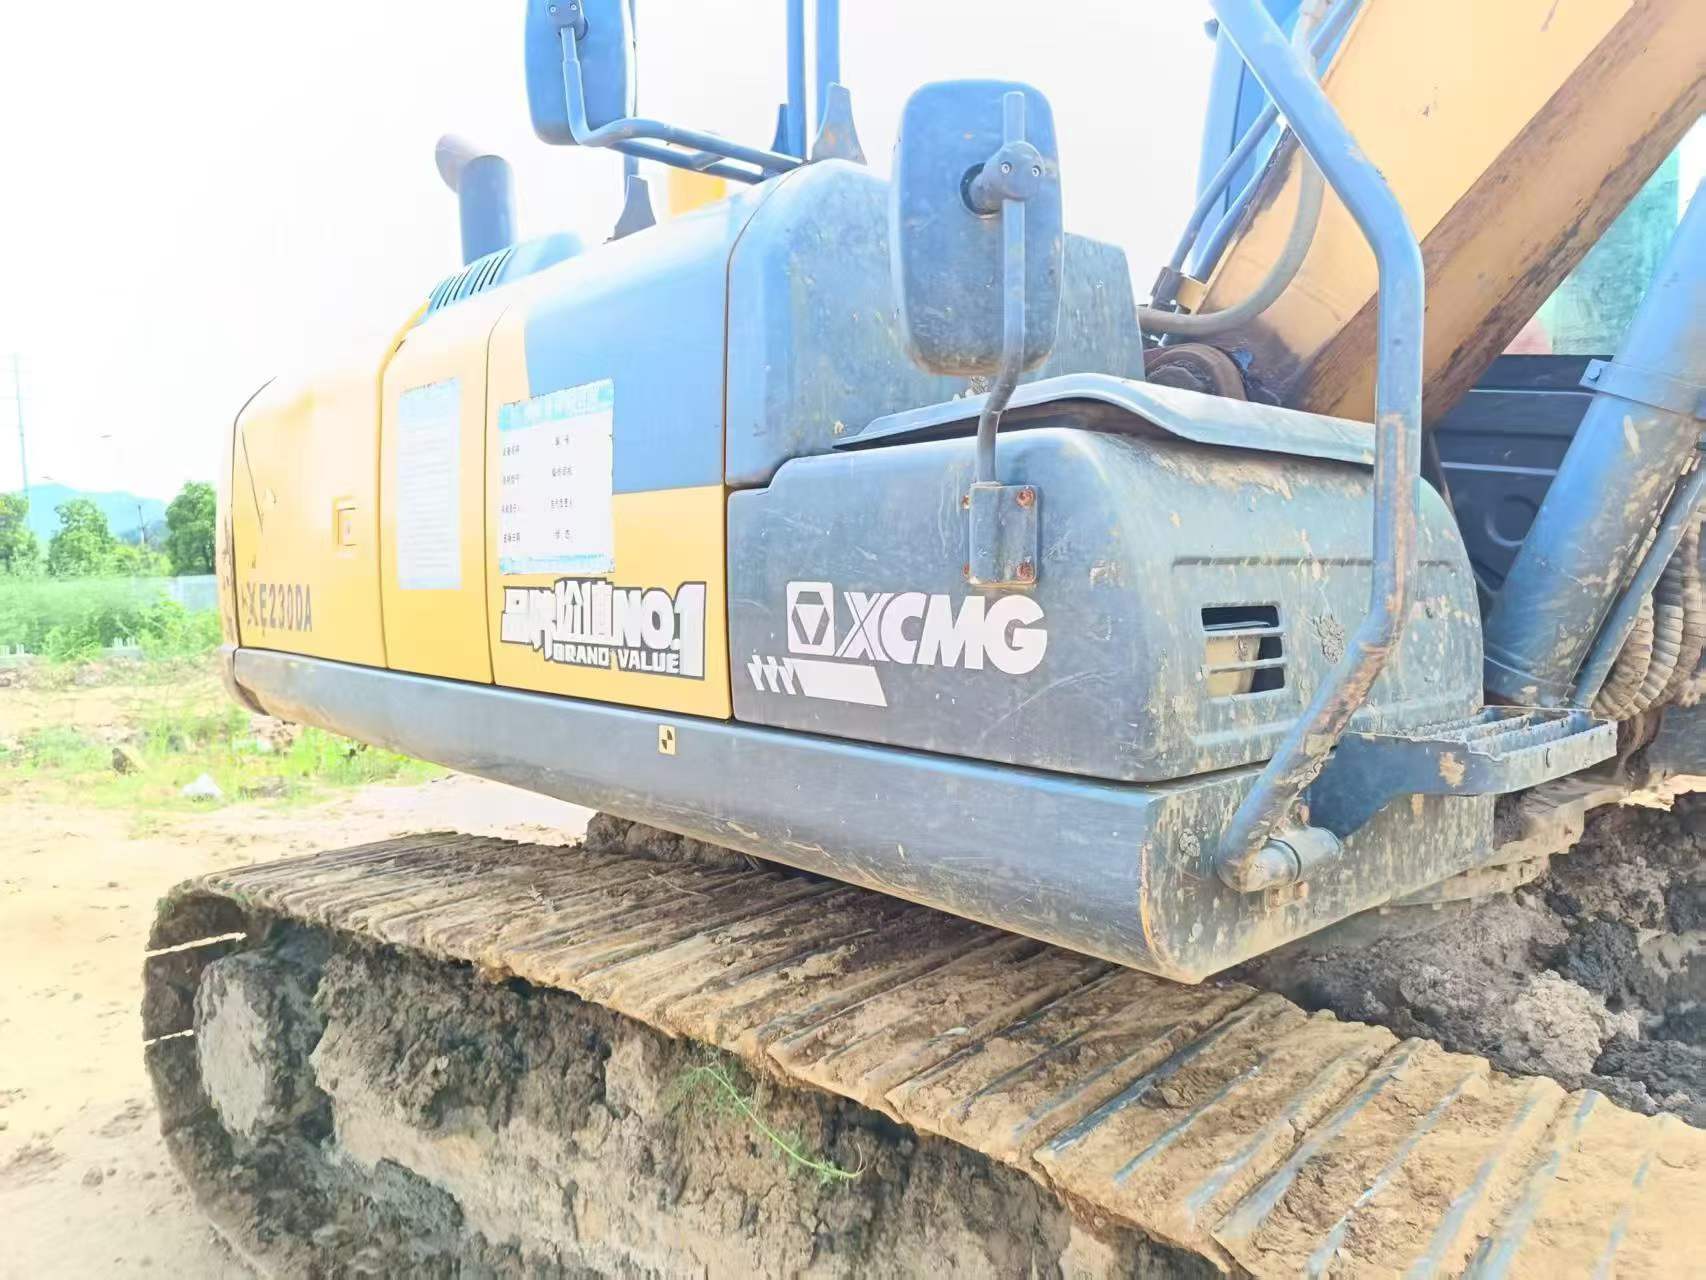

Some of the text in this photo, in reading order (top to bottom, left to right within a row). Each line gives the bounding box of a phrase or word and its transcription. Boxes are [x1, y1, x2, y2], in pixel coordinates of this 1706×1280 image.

[552, 643, 680, 674] BRAND VALUE
[833, 591, 1048, 675] XCMG
